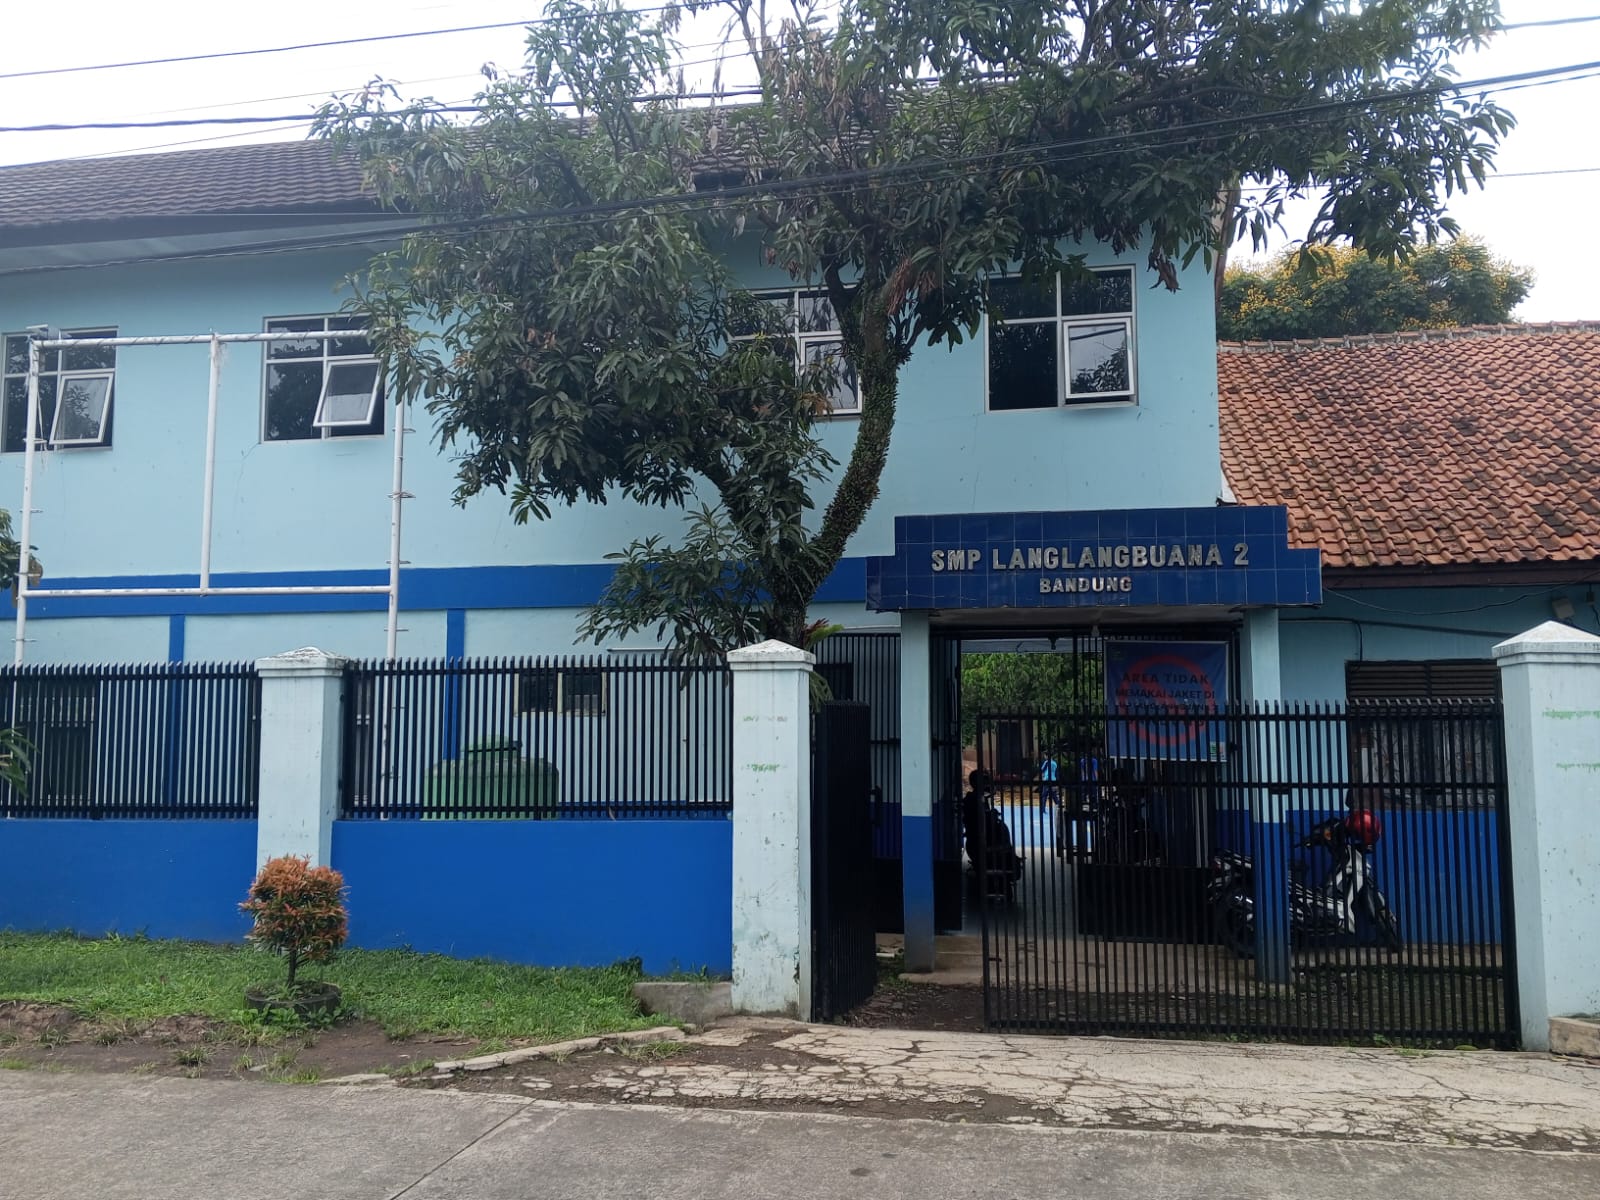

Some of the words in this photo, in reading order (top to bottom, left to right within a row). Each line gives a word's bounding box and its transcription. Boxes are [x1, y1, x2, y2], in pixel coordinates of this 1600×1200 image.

[931, 549, 982, 572] SMP
[992, 543, 1224, 570] LANGLANGBUANA
[1233, 542, 1250, 566] 2
[1039, 576, 1133, 593] BANDUNG
[1122, 672, 1159, 683] AREA
[1163, 672, 1209, 684] TIDAK
[1167, 689, 1202, 699] JAKET
[1204, 690, 1215, 699] DI
